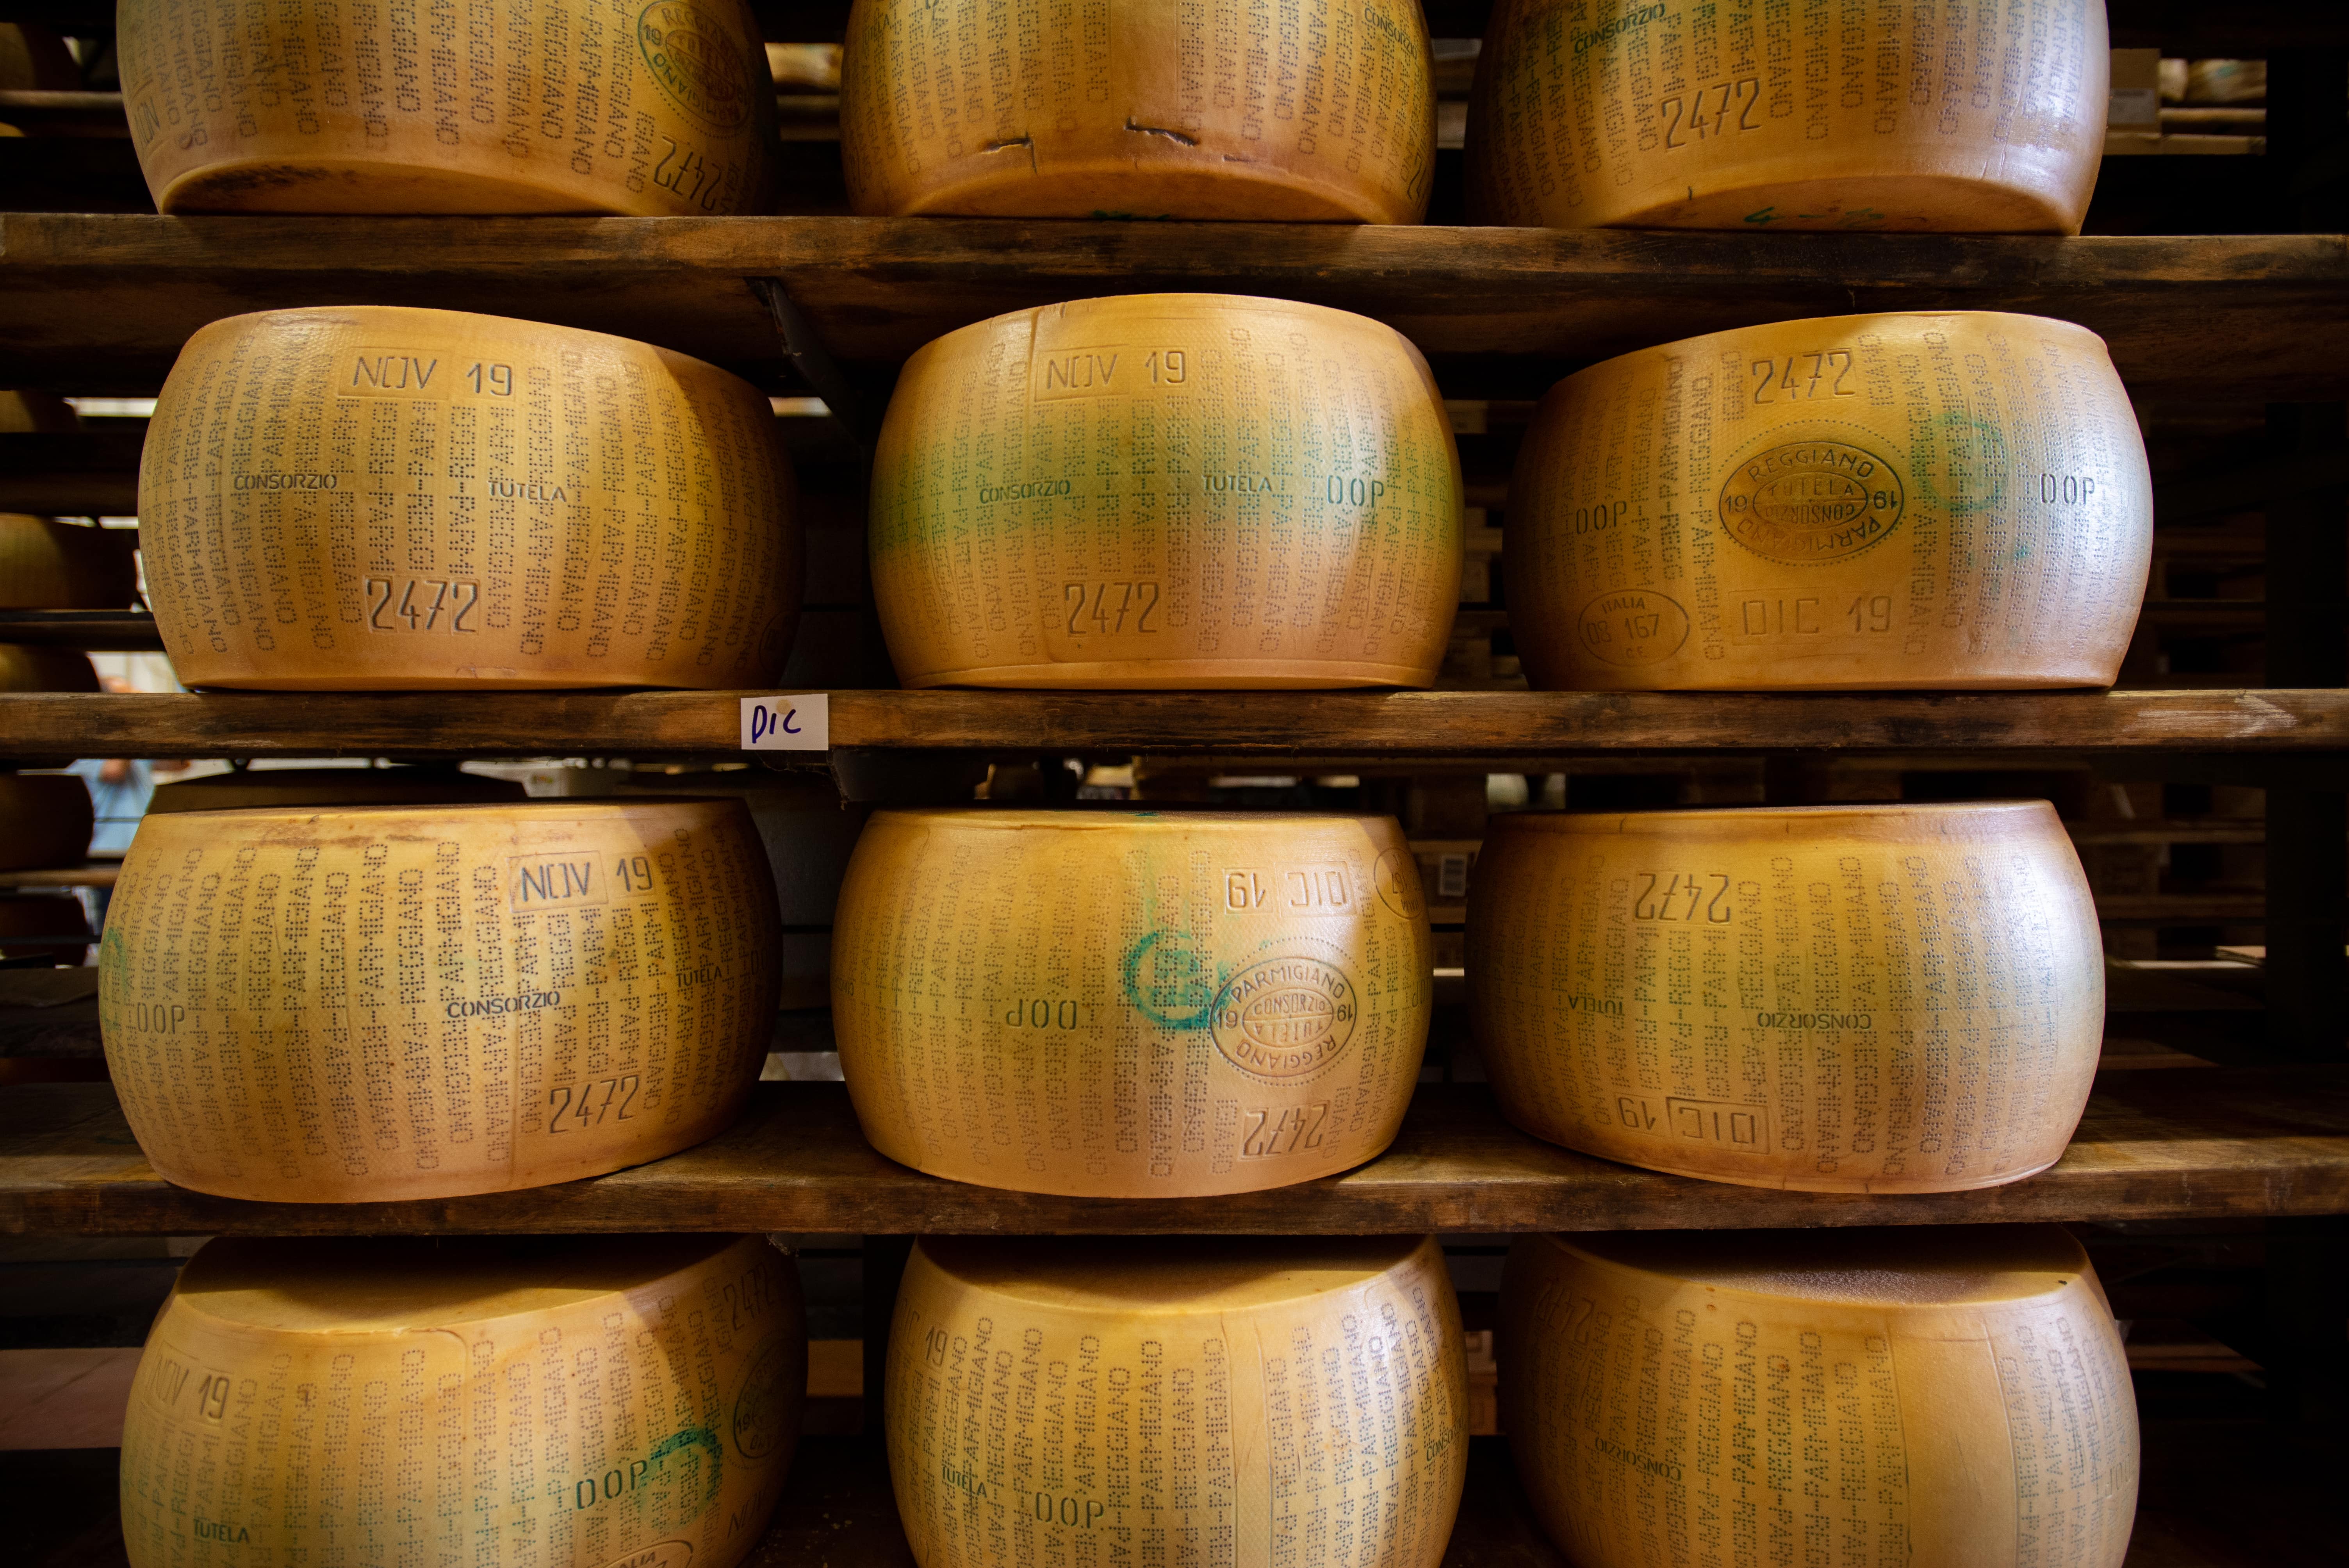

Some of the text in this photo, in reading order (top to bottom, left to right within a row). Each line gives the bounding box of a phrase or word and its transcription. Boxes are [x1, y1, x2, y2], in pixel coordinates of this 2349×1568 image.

[1574, 3, 1665, 54] CONSORZIO
[1661, 77, 1763, 150] 2472
[353, 356, 512, 396] NOV 19
[1047, 350, 1186, 390] NOV 19
[1751, 350, 1855, 405] 2472
[235, 473, 337, 489] CONSORZIO
[1202, 474, 1273, 492] TUTELA
[1747, 448, 1875, 483] REGGIANO
[488, 480, 567, 504] TUTELA
[980, 479, 1071, 504] CONSORZIO
[1327, 474, 1384, 508] DOP
[1725, 494, 1748, 513] 19
[1768, 478, 1855, 496] TUTELA
[2040, 472, 2096, 506] DOP
[1576, 500, 1627, 535] DOP
[367, 578, 479, 633] 2472
[1065, 581, 1160, 636] 2472
[1602, 597, 1645, 614] ITALIA
[1743, 595, 1891, 636] DIC 19
[1625, 613, 1659, 640] 167
[521, 855, 653, 902] NOV 19
[1227, 872, 1267, 909] 19
[1634, 873, 1731, 924] 2472
[678, 966, 722, 988] TUTELA
[1230, 965, 1345, 1003] PARMIGIANO
[137, 1002, 185, 1034] DOP
[447, 991, 560, 1018] CONSORZIO
[1005, 998, 1077, 1030] DOP
[1215, 1007, 1238, 1030] 19
[1254, 993, 1325, 1015] CONSORZIO
[1569, 996, 1625, 1016] TUTELA
[1757, 1012, 1871, 1030] CONSORZIO
[1254, 1021, 1323, 1042] TUTELA
[1236, 1034, 1337, 1070] REGGIANO
[549, 1074, 639, 1133] 2472
[1619, 1098, 1756, 1144] DIC 19
[1242, 1099, 1330, 1160] 2472
[925, 1326, 948, 1366] 19
[198, 1374, 230, 1420] 19
[1595, 1435, 1682, 1481] CONSORZIO
[577, 1459, 648, 1510] DOP
[941, 1463, 987, 1498] TUTELA
[1035, 1491, 1105, 1529] DOP
[194, 1518, 250, 1543] TUTELA
